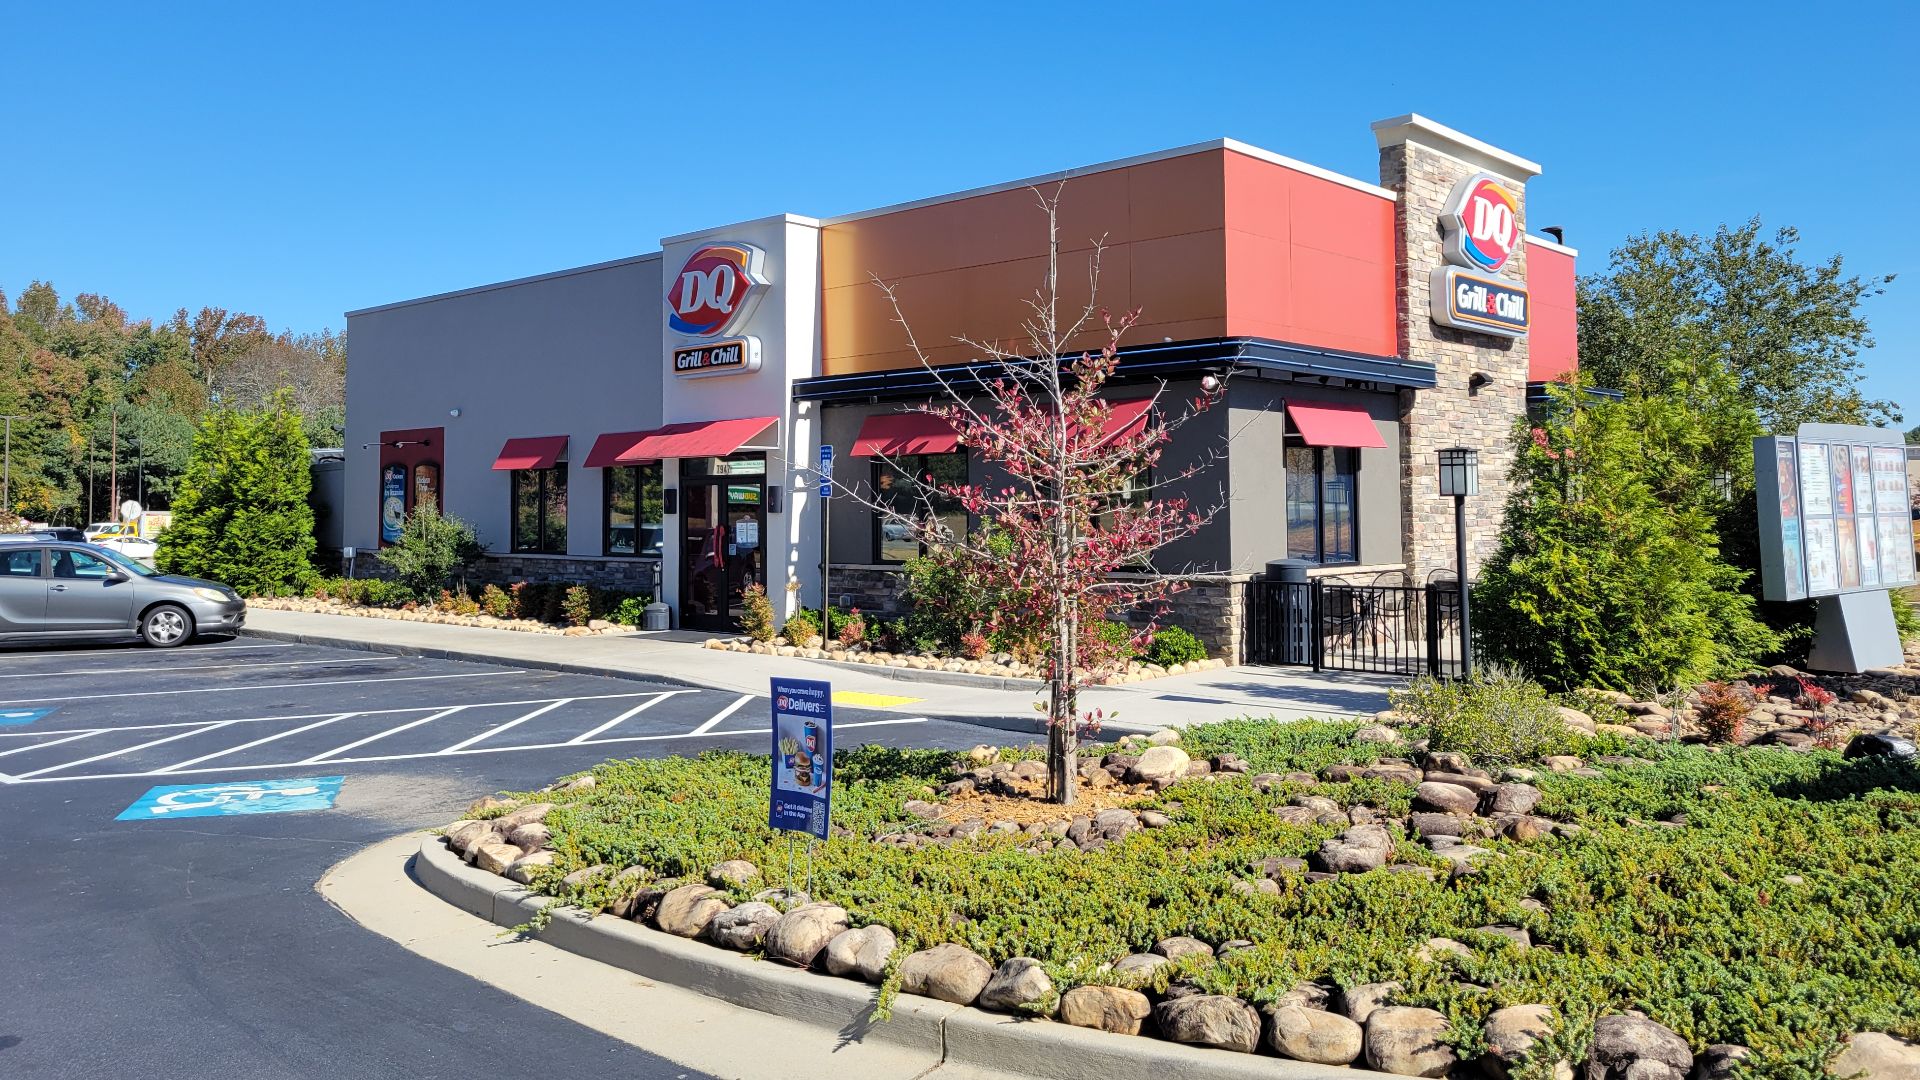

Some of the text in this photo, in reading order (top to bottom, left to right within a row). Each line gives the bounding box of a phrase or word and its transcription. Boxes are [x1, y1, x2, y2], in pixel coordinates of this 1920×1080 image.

[1473, 195, 1513, 254] DQ
[678, 264, 736, 314] DQ
[788, 698, 820, 713] Delivers
